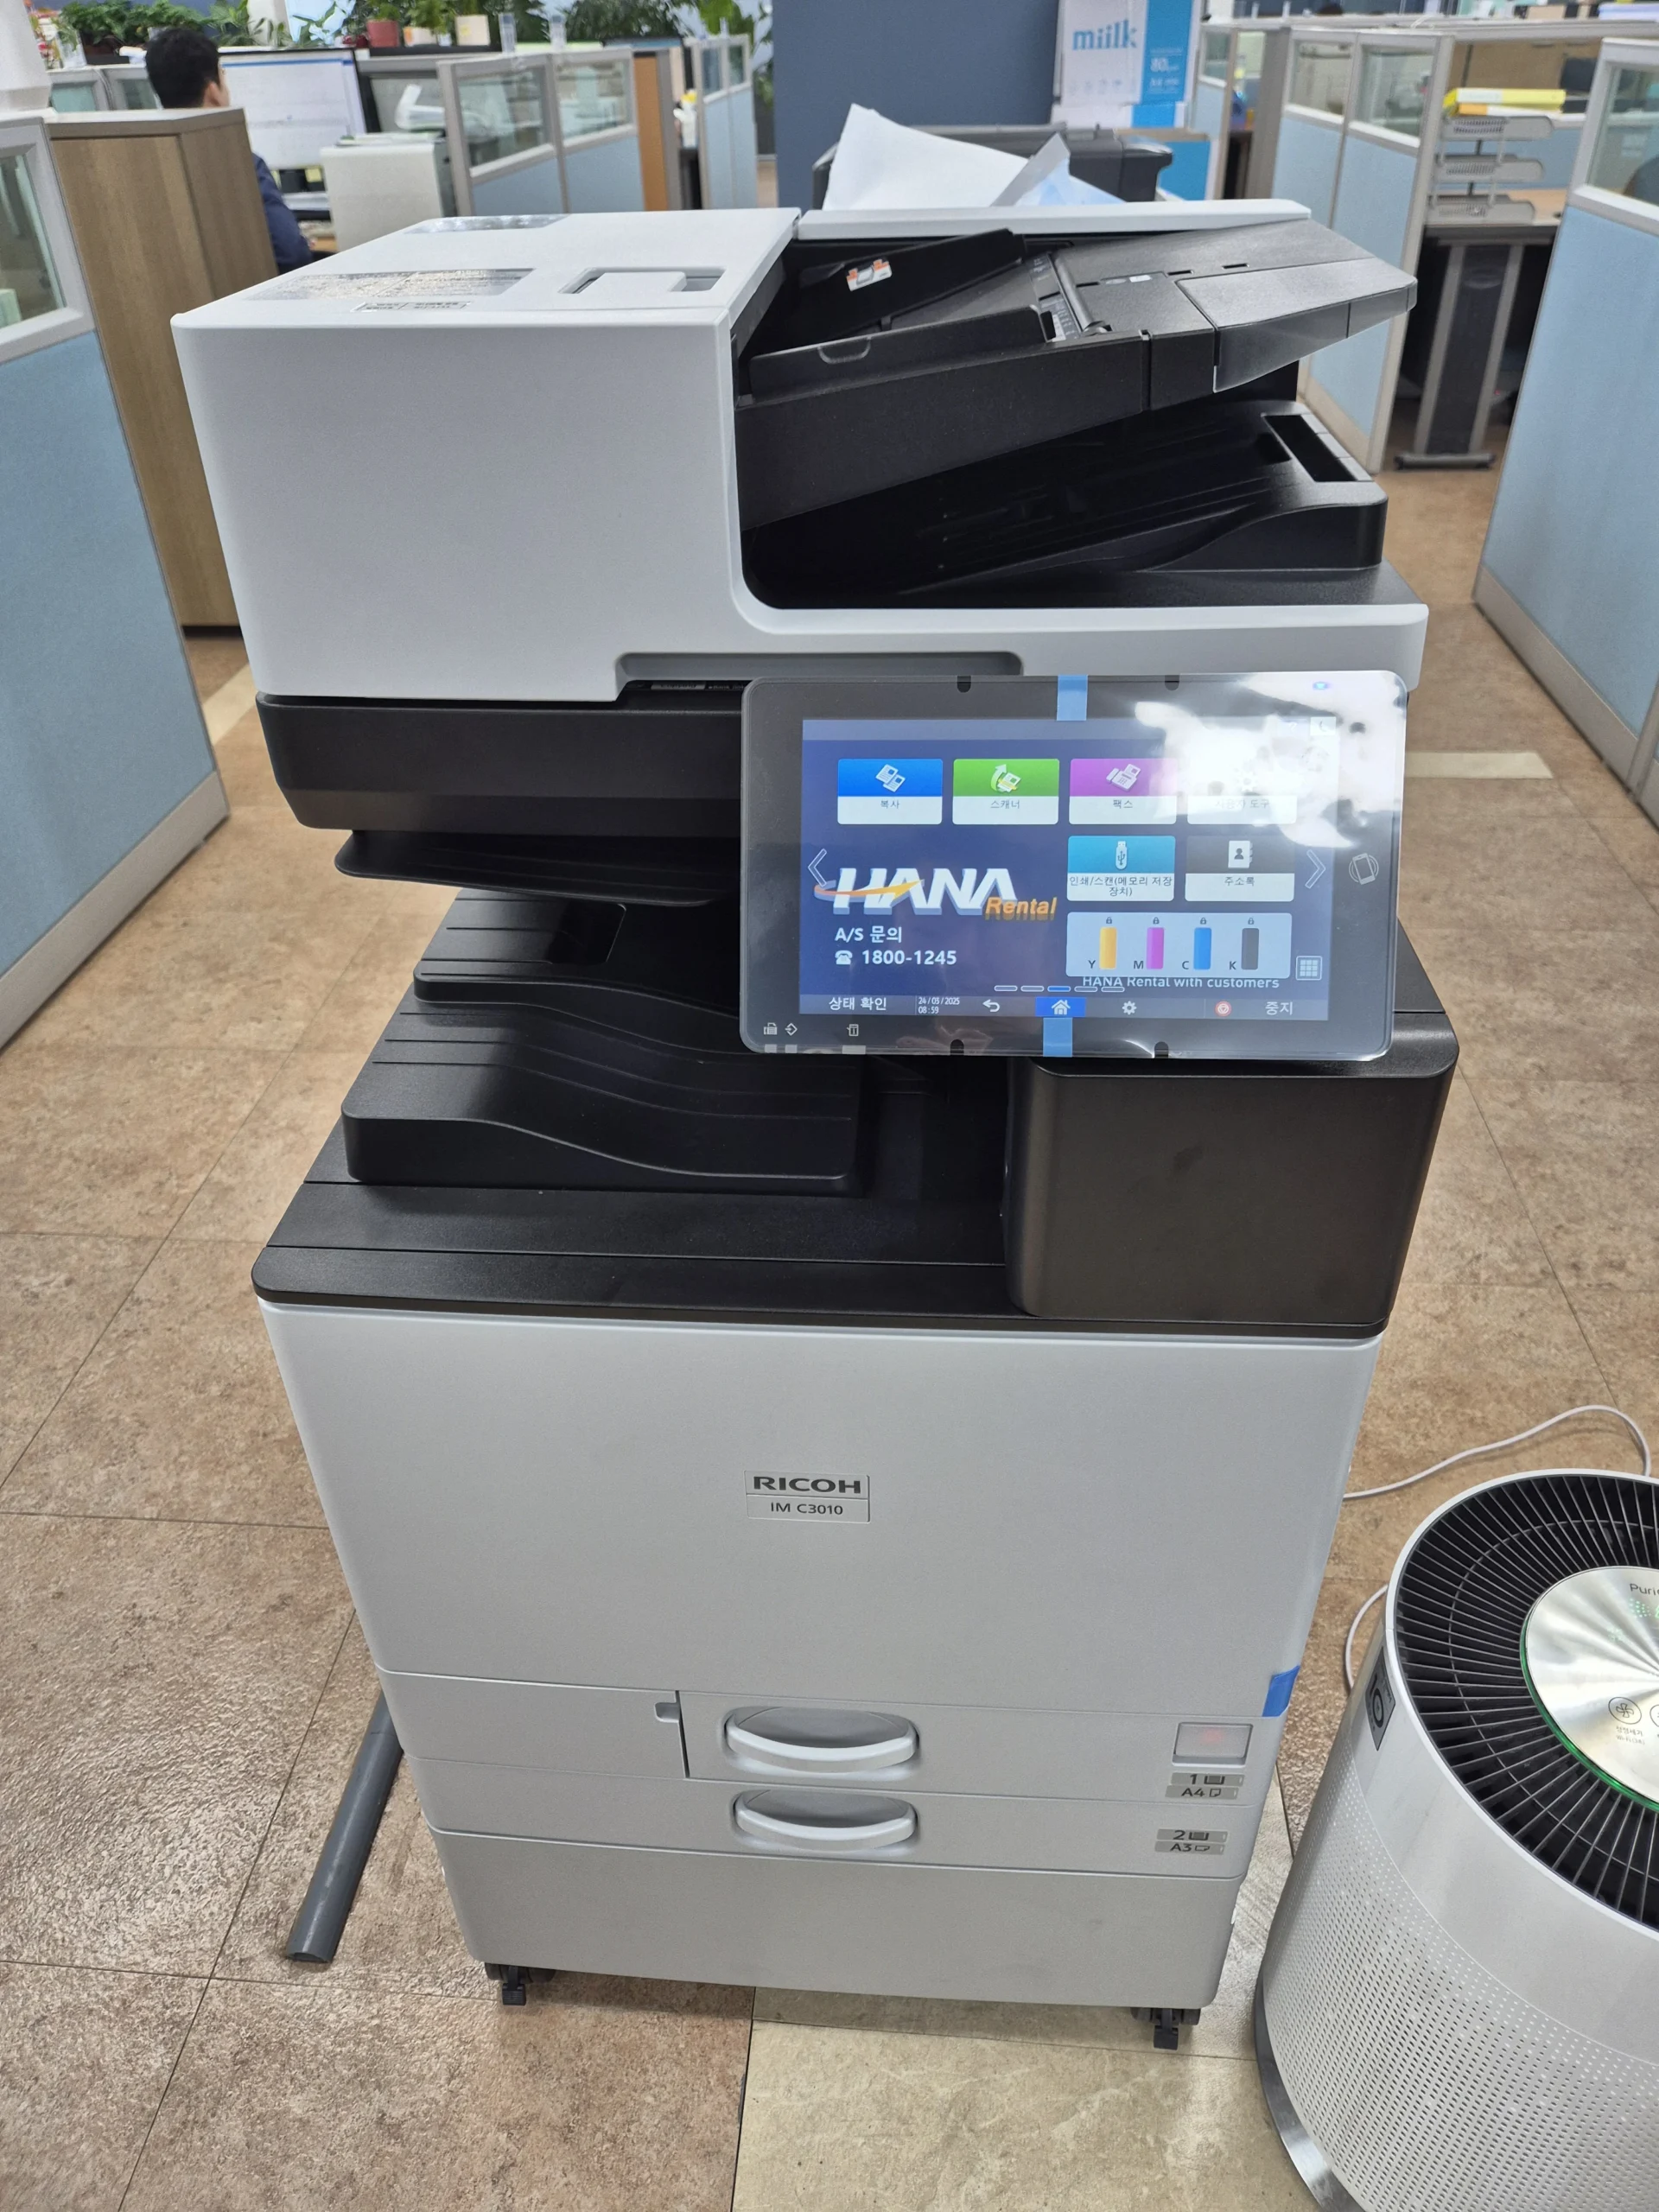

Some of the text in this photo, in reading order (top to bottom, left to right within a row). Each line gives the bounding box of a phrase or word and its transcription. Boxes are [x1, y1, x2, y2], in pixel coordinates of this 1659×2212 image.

[1072, 19, 1137, 50] miilk
[880, 799, 900, 810] 복사
[990, 800, 1020, 810] 스캐너
[1113, 799, 1134, 809] 팩스
[1250, 799, 1270, 809] 도구
[1069, 876, 1173, 887] 인쇄/스캔(메모리 저장
[1224, 876, 1255, 887] 주소록
[833, 868, 1018, 916] HANA
[1109, 887, 1133, 897] 장치)
[984, 897, 1058, 921] Rental
[835, 926, 903, 944] A/S 문의
[861, 950, 957, 965] 1800-1245
[1088, 960, 1096, 969] Y
[1133, 961, 1144, 969] M
[1181, 961, 1190, 970] C
[1229, 961, 1237, 970] K
[1082, 976, 1280, 988] HANA Rental with customers
[829, 997, 887, 1011] 상태 확인
[1265, 1001, 1294, 1015] 중지
[918, 1006, 939, 1014] 08:59
[753, 1476, 861, 1494] RICOH
[771, 1502, 843, 1515] IM C3010
[1190, 1774, 1198, 1784] 1
[1181, 1788, 1205, 1797] A4
[1173, 1830, 1185, 1840] 2
[1170, 1843, 1192, 1852] A3
